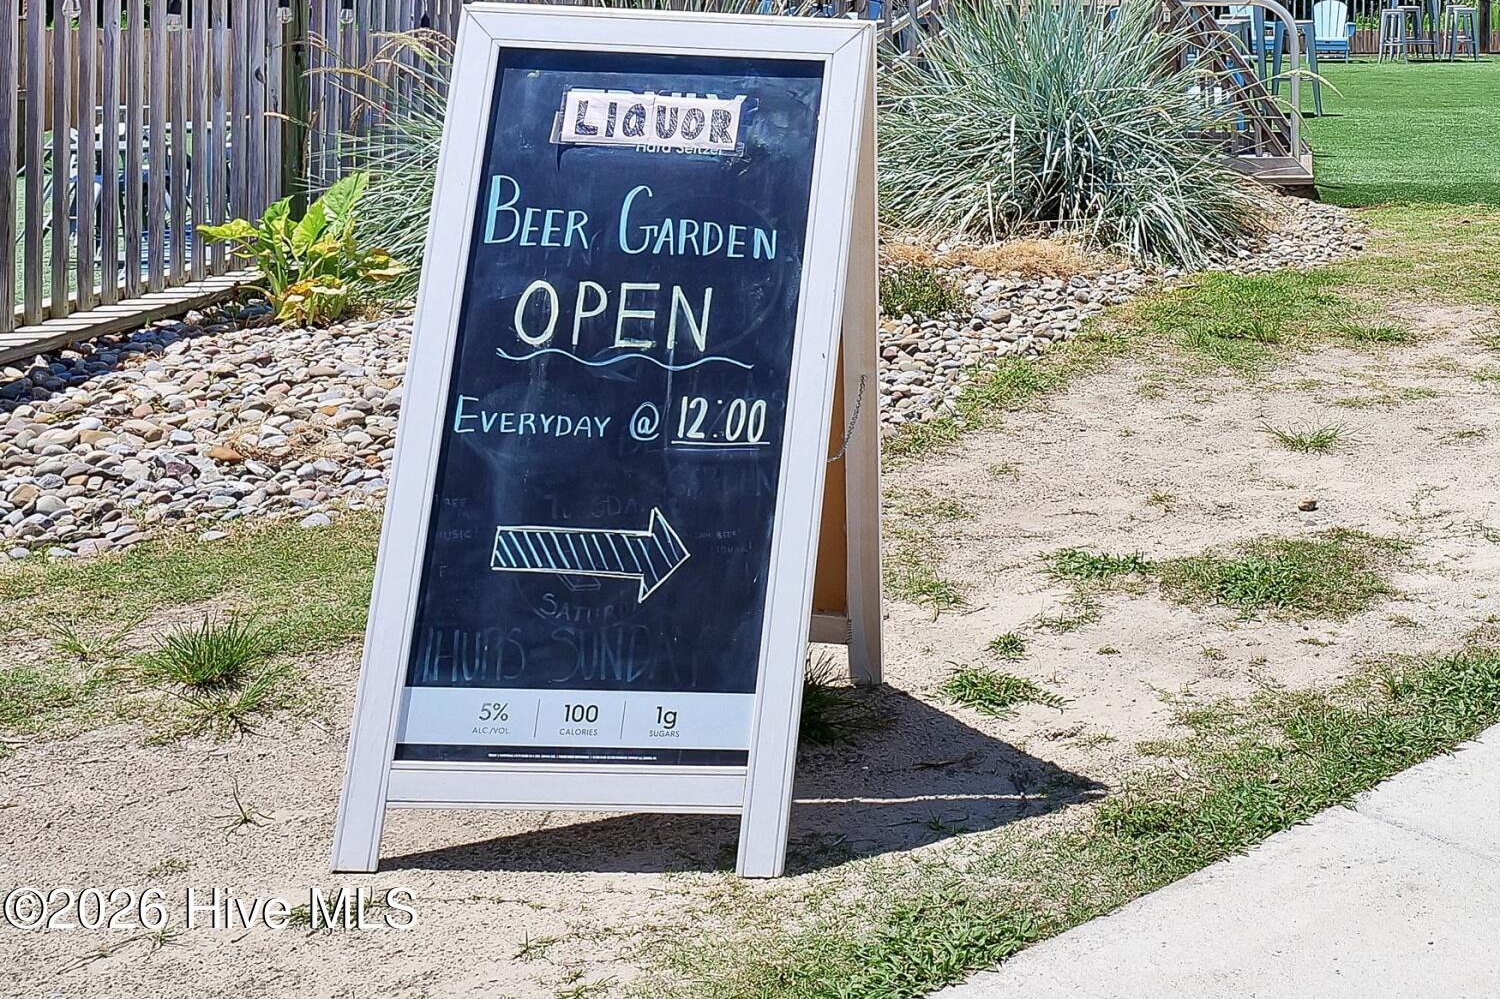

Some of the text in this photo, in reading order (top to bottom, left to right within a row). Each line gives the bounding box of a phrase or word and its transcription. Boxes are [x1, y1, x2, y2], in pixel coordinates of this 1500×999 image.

[574, 99, 733, 144] LIQUOR
[483, 174, 778, 261] BEER GARDEN
[513, 279, 713, 353] OPEN
[453, 394, 768, 443] EVERYDAY @ 12:00
[478, 702, 509, 722] 5%
[564, 704, 599, 723] 100
[656, 706, 678, 730] 1g
[559, 728, 599, 737] CALORIES
[649, 730, 680, 738] SUGARS
